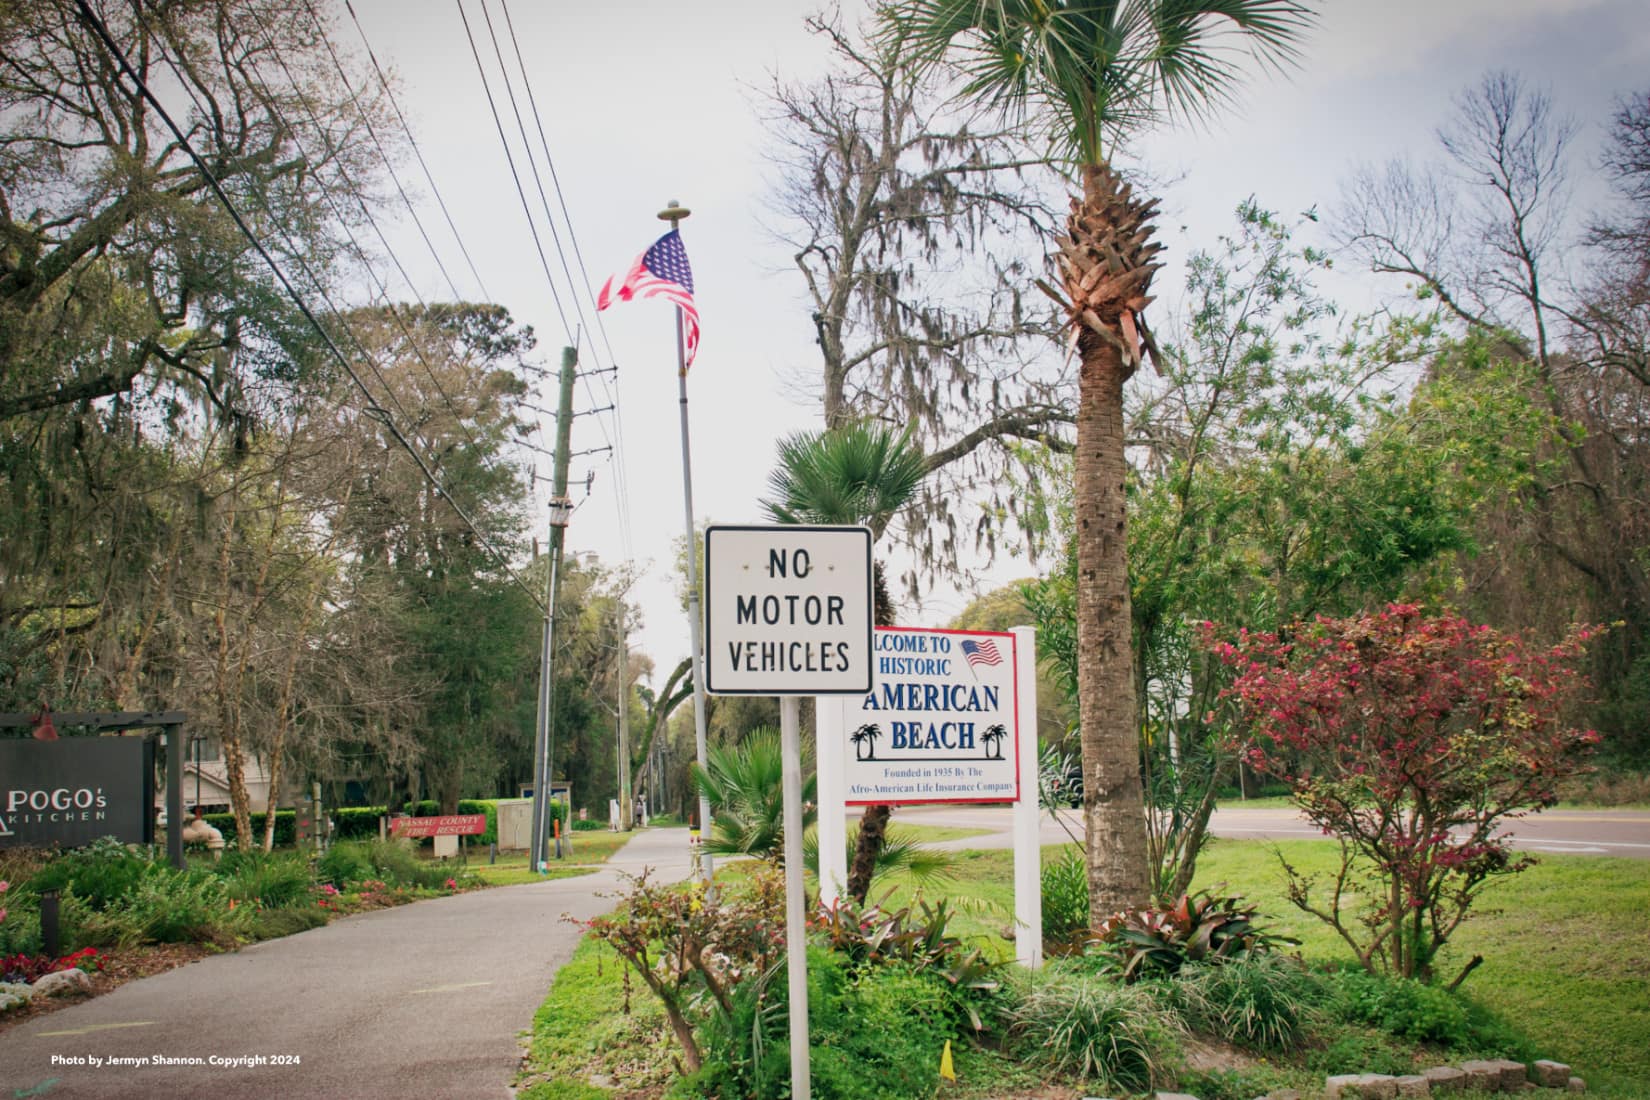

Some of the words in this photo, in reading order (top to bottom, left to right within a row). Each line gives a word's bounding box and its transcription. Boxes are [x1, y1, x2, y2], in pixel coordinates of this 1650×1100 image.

[769, 548, 810, 578] NO
[736, 595, 845, 625] MOTOR
[874, 634, 928, 653] LCOME
[930, 636, 951, 654] TO
[728, 641, 849, 672] VEHICLES
[879, 657, 952, 676] HISTORIC
[862, 683, 999, 712] AMERICAN
[891, 721, 976, 750] BEACH
[884, 767, 921, 778] Founded
[923, 767, 932, 777] in
[934, 767, 953, 777] 1935
[967, 767, 983, 777] The
[850, 784, 914, 794] Afro-American
[916, 783, 934, 793] Life
[935, 782, 975, 792] Insurance
[976, 782, 1013, 793] Company
[6, 788, 107, 812] POGO's
[8, 811, 105, 824] KITCHEN
[399, 818, 434, 827] NASSAU
[440, 816, 479, 826] COUNTY
[407, 826, 430, 836] FIRE
[436, 824, 476, 834] RESCUE
